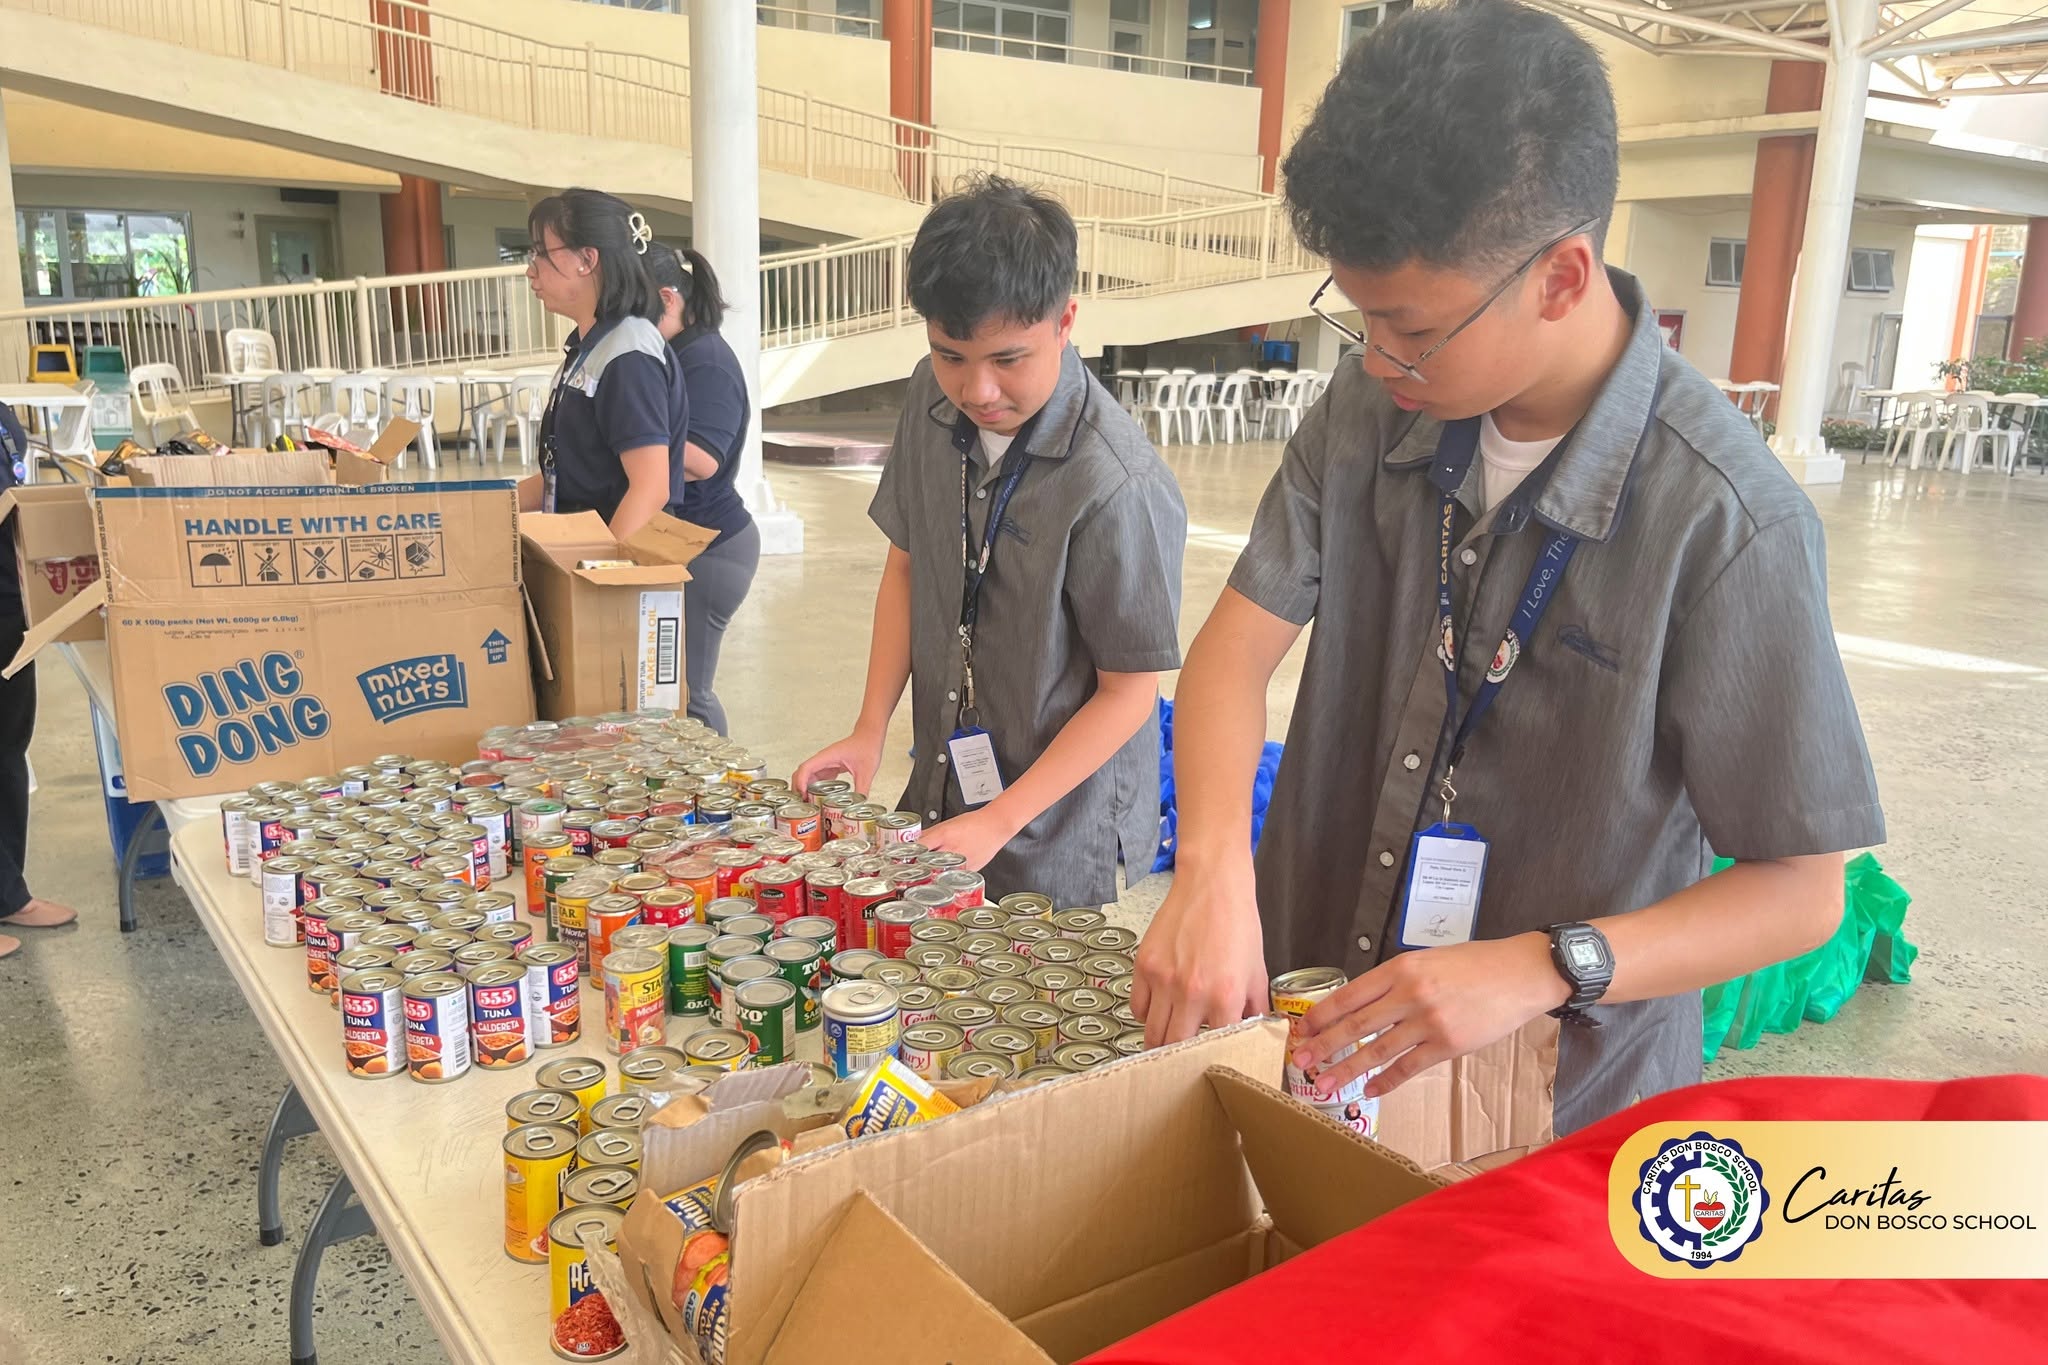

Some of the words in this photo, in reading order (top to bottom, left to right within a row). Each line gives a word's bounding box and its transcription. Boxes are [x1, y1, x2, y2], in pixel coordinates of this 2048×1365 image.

[207, 489, 226, 497] DO
[228, 488, 251, 496] NOT
[255, 488, 300, 496] ACCEPT
[304, 487, 315, 495] IF
[319, 486, 351, 495] PRINT
[356, 486, 366, 494] IS
[370, 485, 415, 494] BROKEN
[185, 518, 293, 536] HANDLE
[301, 514, 368, 534] WITH
[376, 512, 442, 531] CARE
[1440, 503, 1454, 585] CARITAS
[1526, 568, 1556, 609] Love,
[145, 618, 166, 627] 100g
[167, 617, 194, 627] packs
[648, 608, 657, 627] OIL
[648, 631, 656, 643] IN
[367, 656, 450, 693] mixed
[646, 647, 656, 697] FLAKES
[162, 651, 303, 729] DING
[376, 680, 449, 712] nuts
[176, 696, 330, 777] DONG
[822, 936, 837, 952] YO
[802, 958, 820, 975] TO
[480, 989, 513, 1006] 555
[687, 998, 710, 1010] OYO
[346, 1016, 372, 1027] TUNA
[483, 1008, 513, 1019] TUNA
[477, 1019, 520, 1033] CALDERETA
[671, 1194, 711, 1228] ntina
